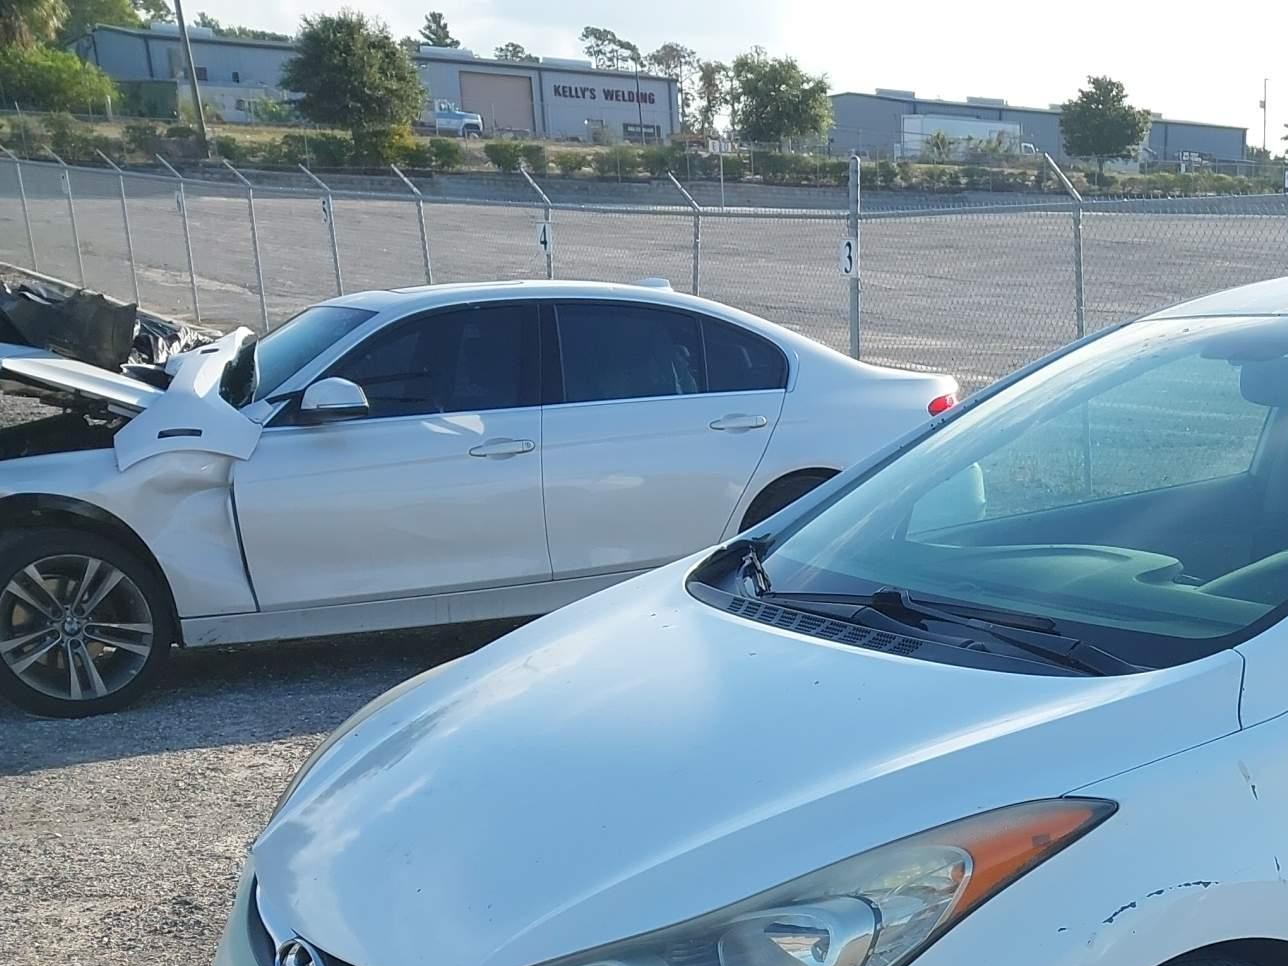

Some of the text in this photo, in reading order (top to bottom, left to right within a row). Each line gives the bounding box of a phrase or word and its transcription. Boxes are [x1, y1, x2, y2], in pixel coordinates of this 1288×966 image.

[553, 84, 656, 105] KELLY'S WELDING
[539, 223, 548, 251] 4
[844, 241, 853, 274] 3
